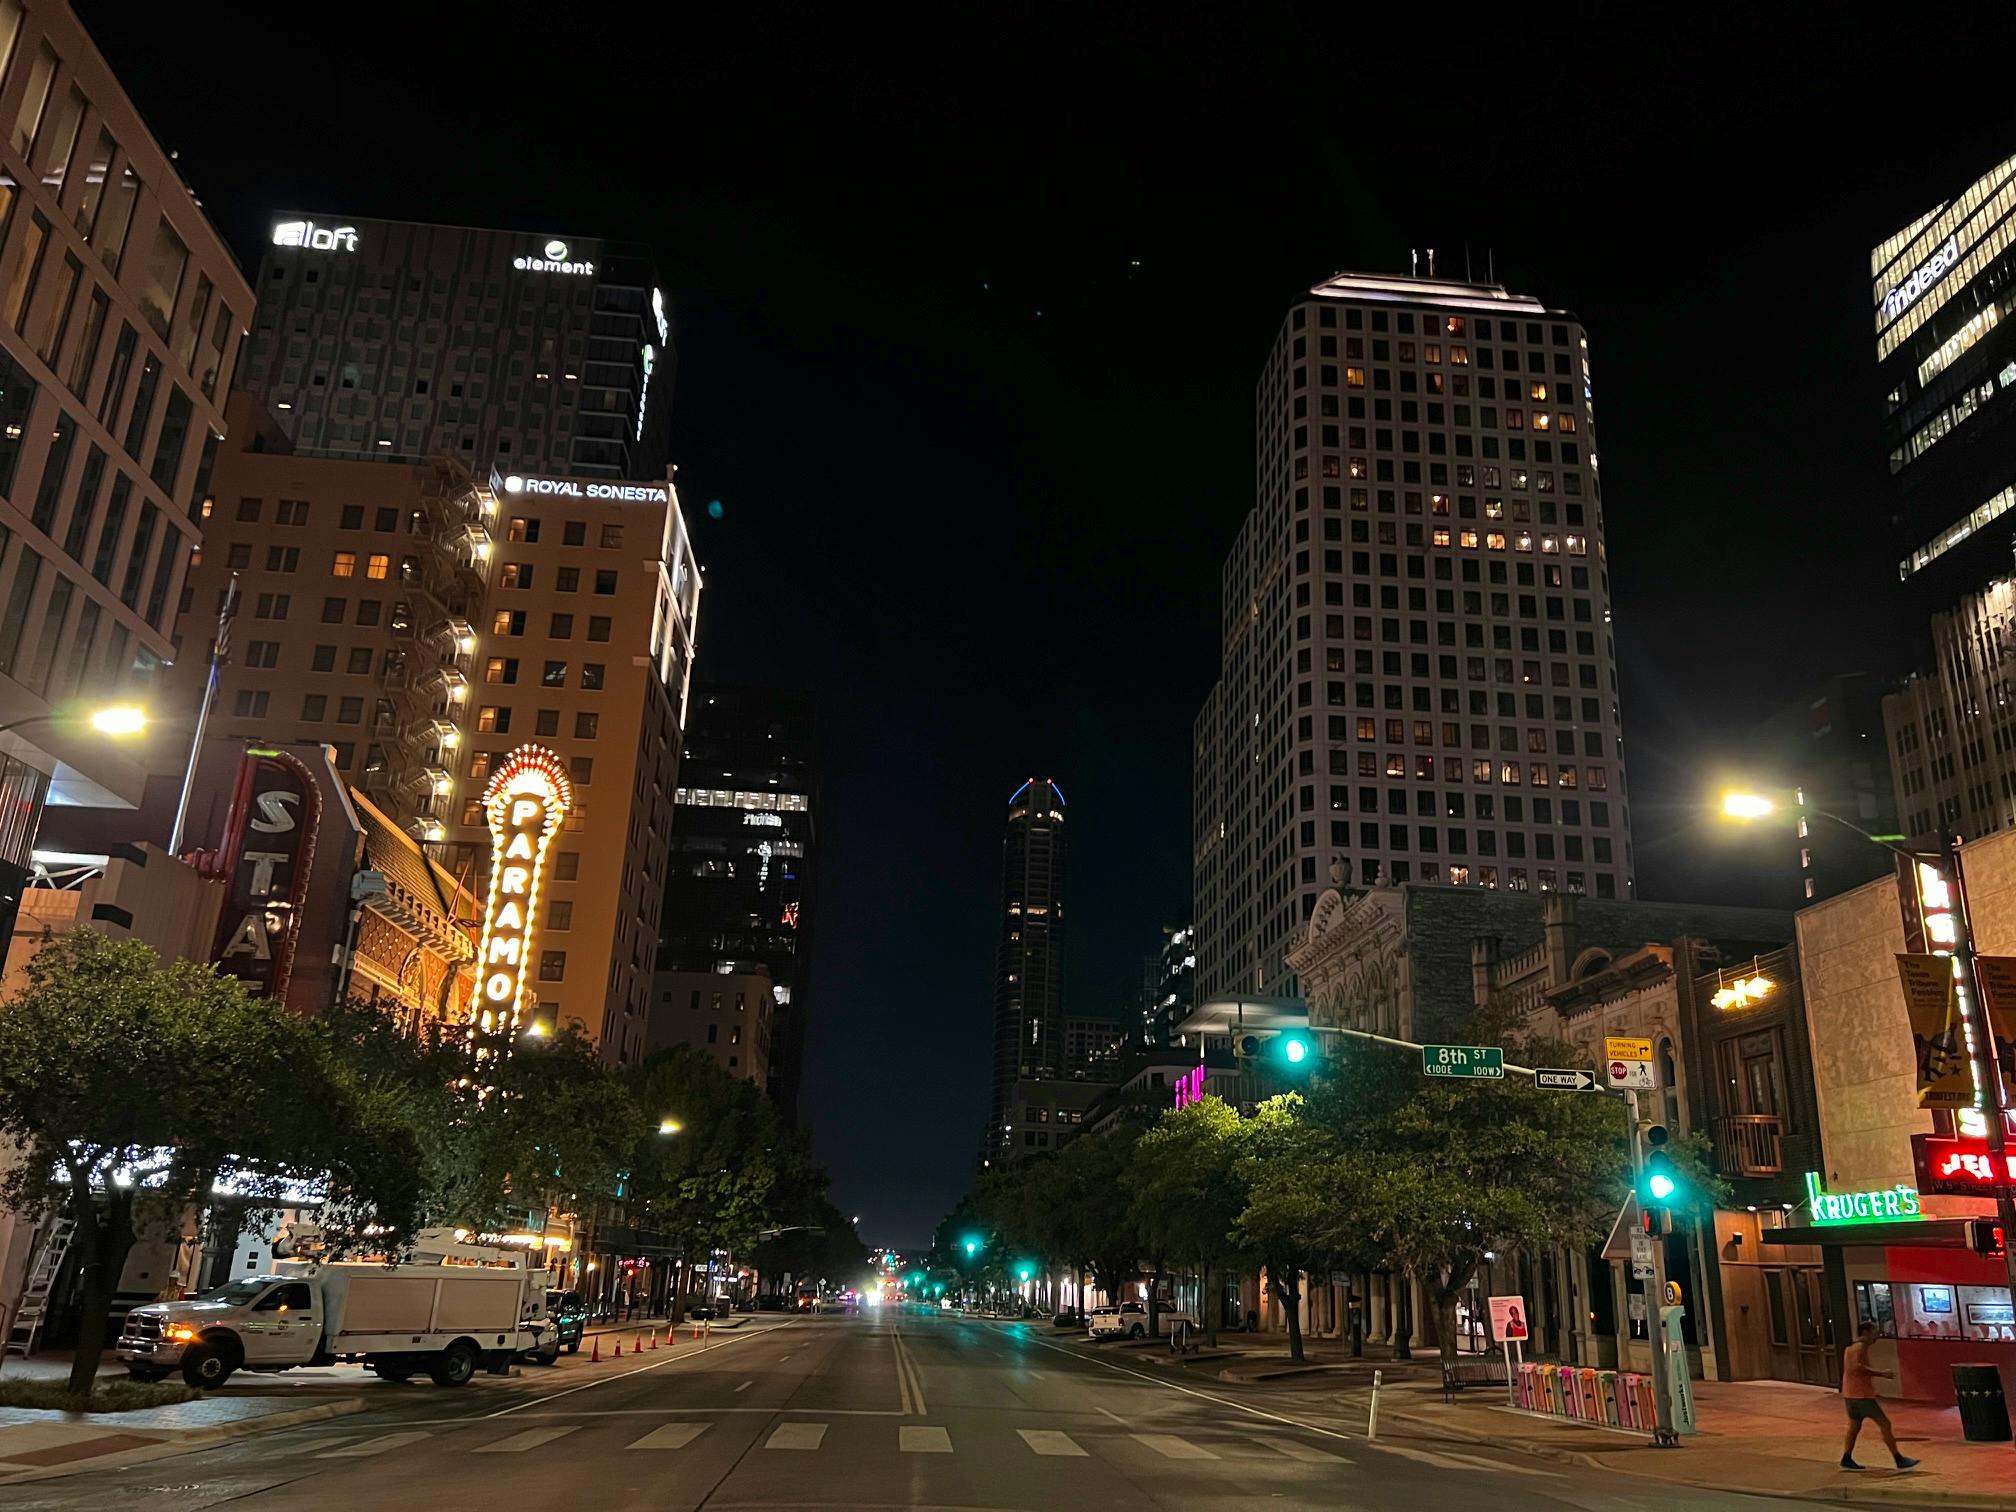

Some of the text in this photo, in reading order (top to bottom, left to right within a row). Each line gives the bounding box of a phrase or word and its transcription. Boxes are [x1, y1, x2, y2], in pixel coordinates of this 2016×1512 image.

[273, 221, 357, 252] aloft
[513, 256, 594, 276] element
[1883, 234, 1959, 321] indeed
[526, 478, 667, 502] ROYAL SONESTA
[1609, 1041, 1636, 1049] TURNING
[1438, 1048, 1487, 1065] 8th ST
[1609, 1050, 1638, 1058] VEHICLES
[1432, 1064, 1494, 1076] 100E 100W
[1610, 1066, 1627, 1075] STOP
[1541, 1075, 1577, 1085] ONE WAY
[1806, 1171, 1922, 1221] KRUGER'S
